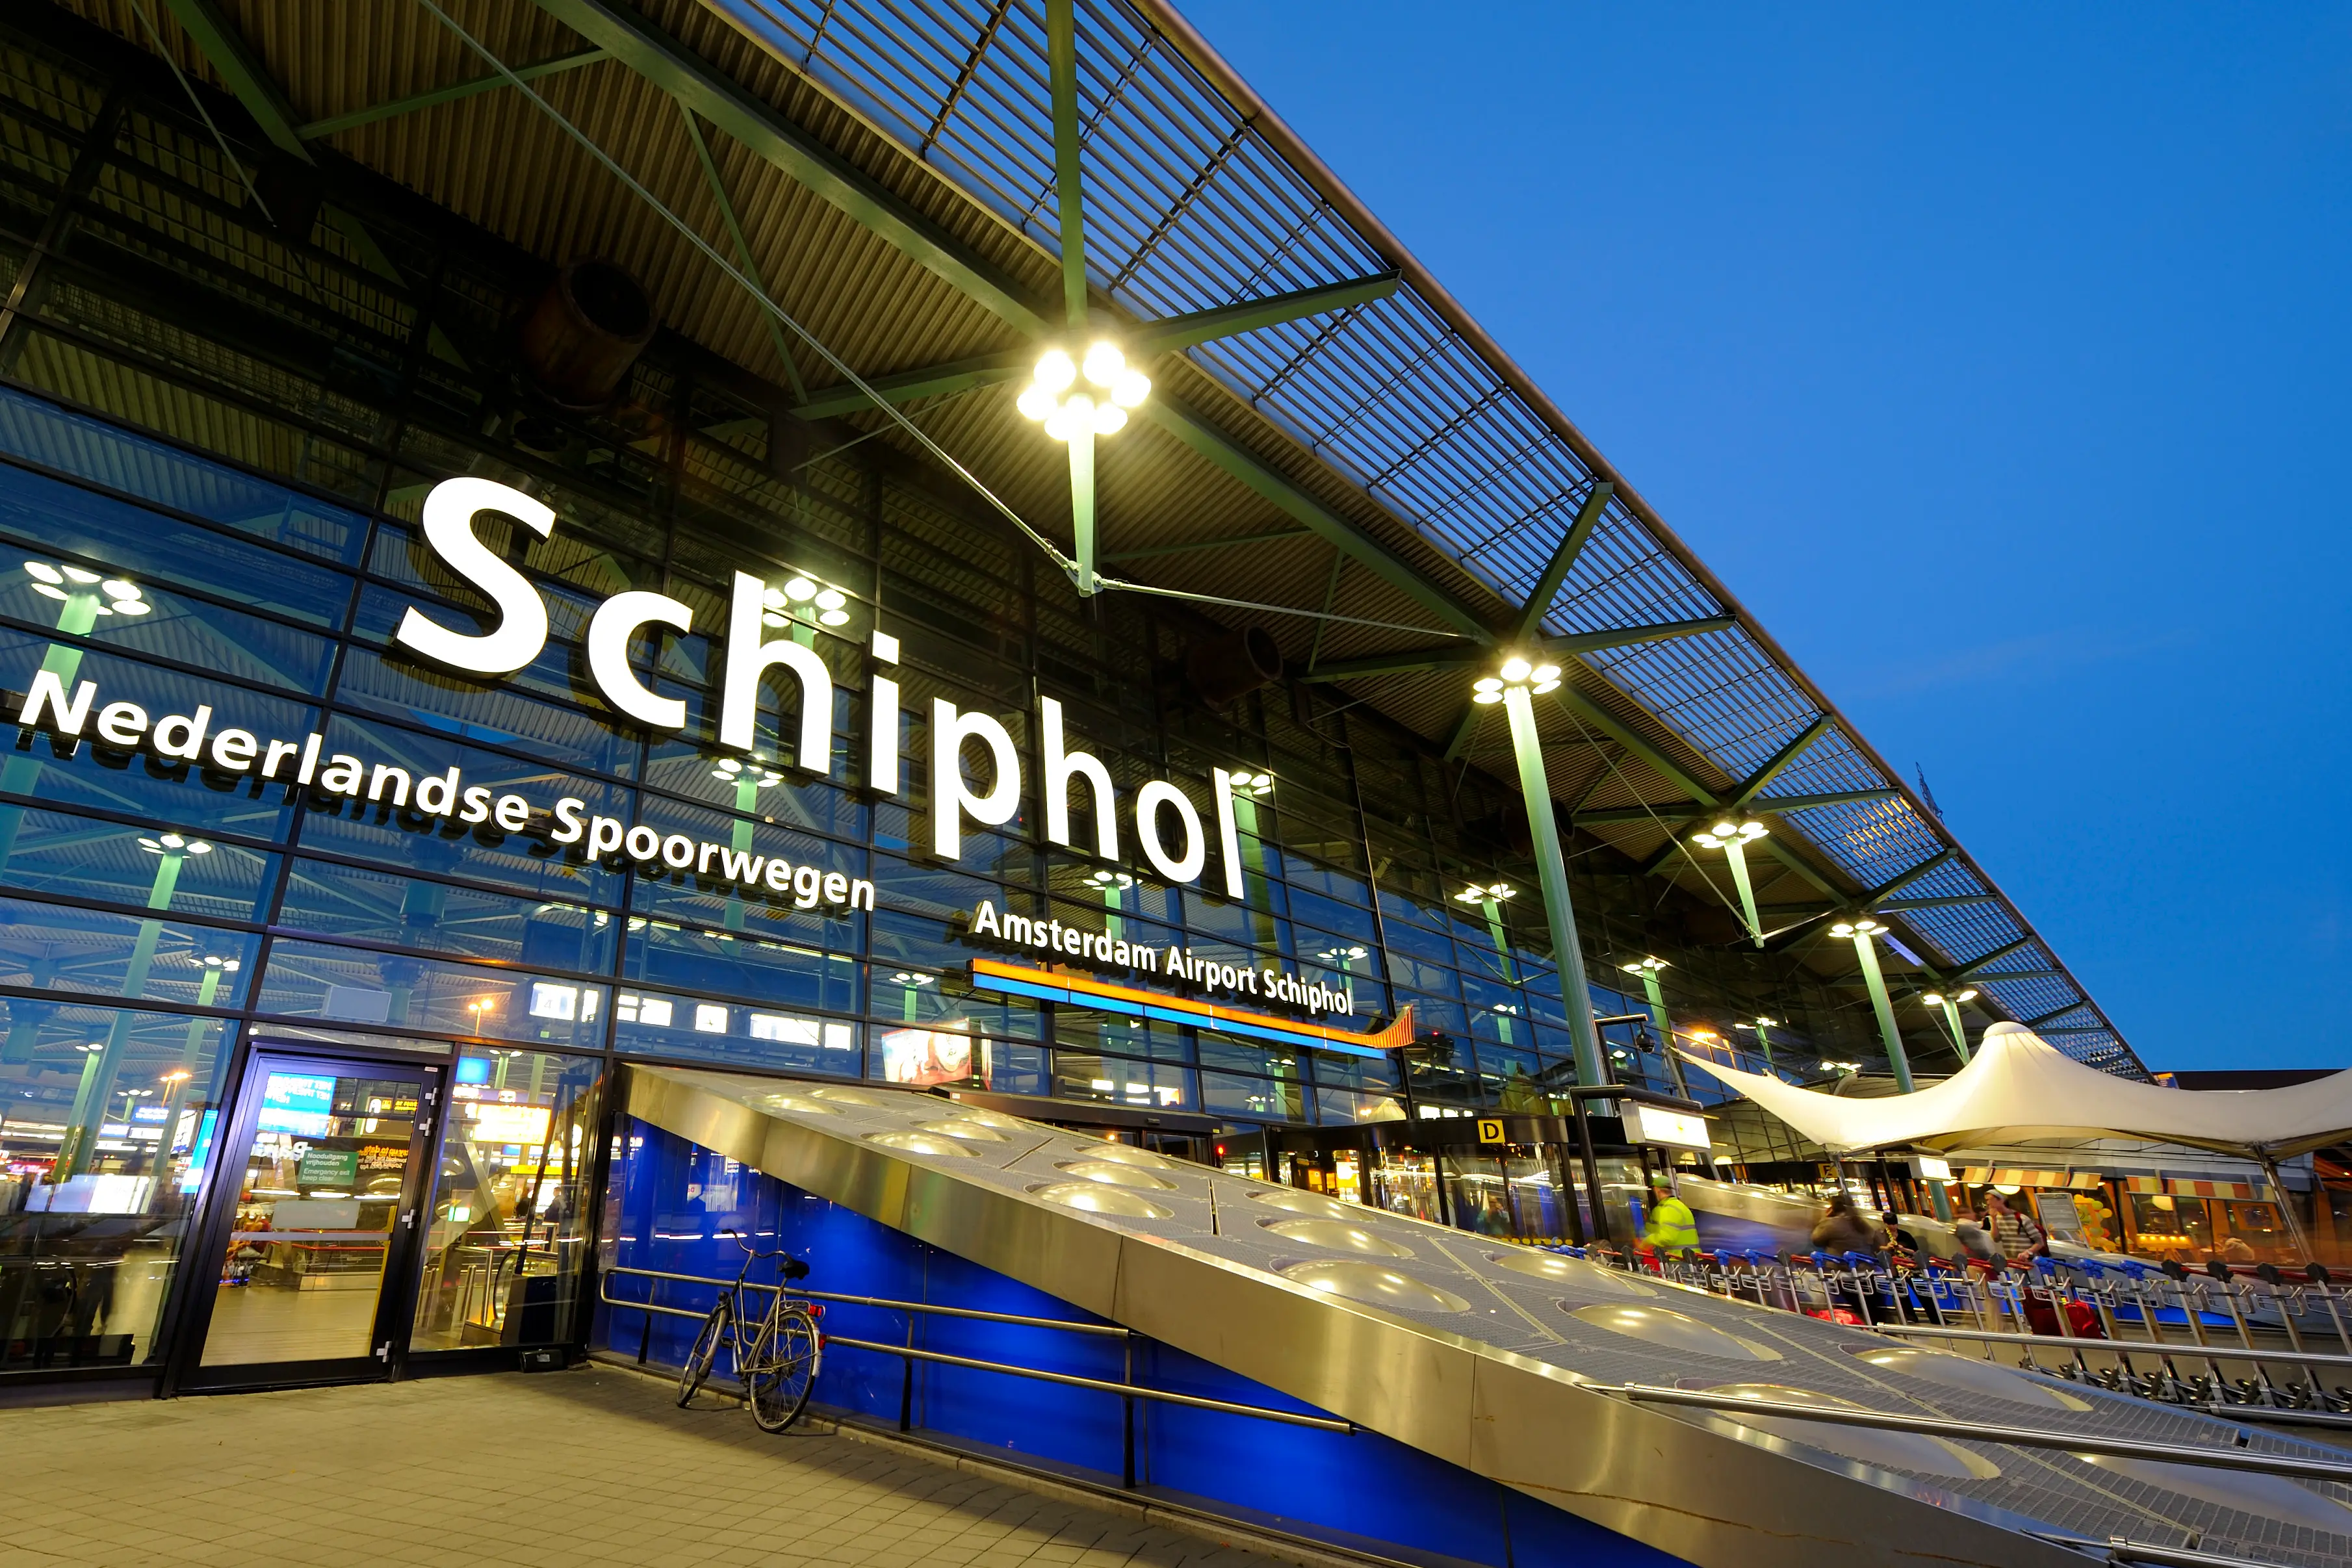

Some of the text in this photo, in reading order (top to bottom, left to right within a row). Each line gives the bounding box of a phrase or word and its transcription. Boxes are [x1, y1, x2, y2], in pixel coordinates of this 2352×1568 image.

[396, 476, 1245, 899] Schiphol
[18, 669, 875, 912] Nederlandse Spoorwegen
[974, 900, 1354, 1016] Amsterdam Airport Schiphol
[307, 1153, 348, 1161] Nooduitgang
[1484, 1123, 1499, 1140] D
